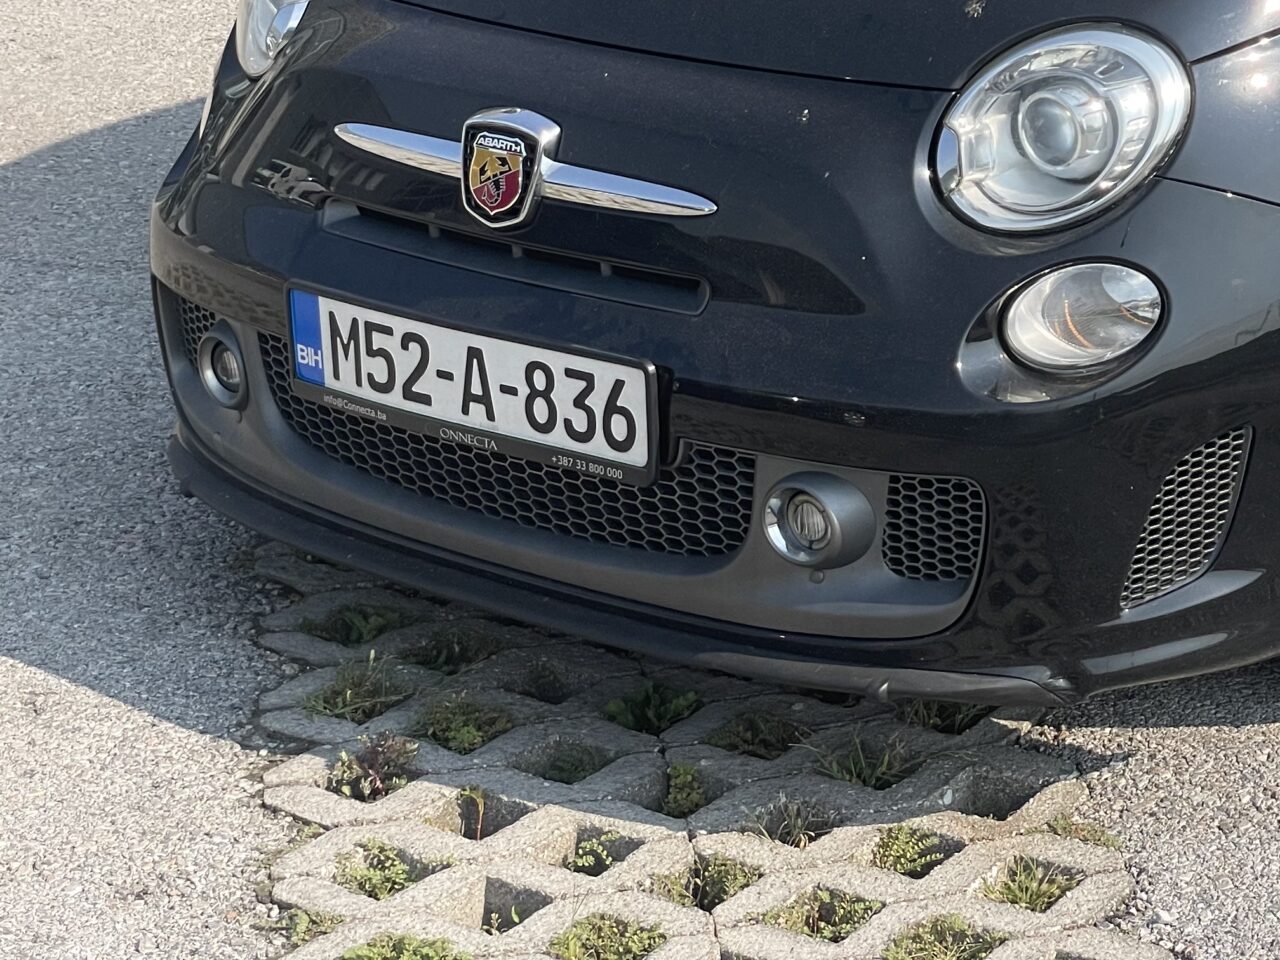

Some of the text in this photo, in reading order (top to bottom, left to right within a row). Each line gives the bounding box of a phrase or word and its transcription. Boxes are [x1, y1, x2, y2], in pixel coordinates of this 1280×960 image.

[478, 137, 521, 152] ABARTH
[296, 343, 322, 370] BIH
[328, 310, 637, 453] M52-A-836
[551, 455, 623, 479] +387 33 800 000
